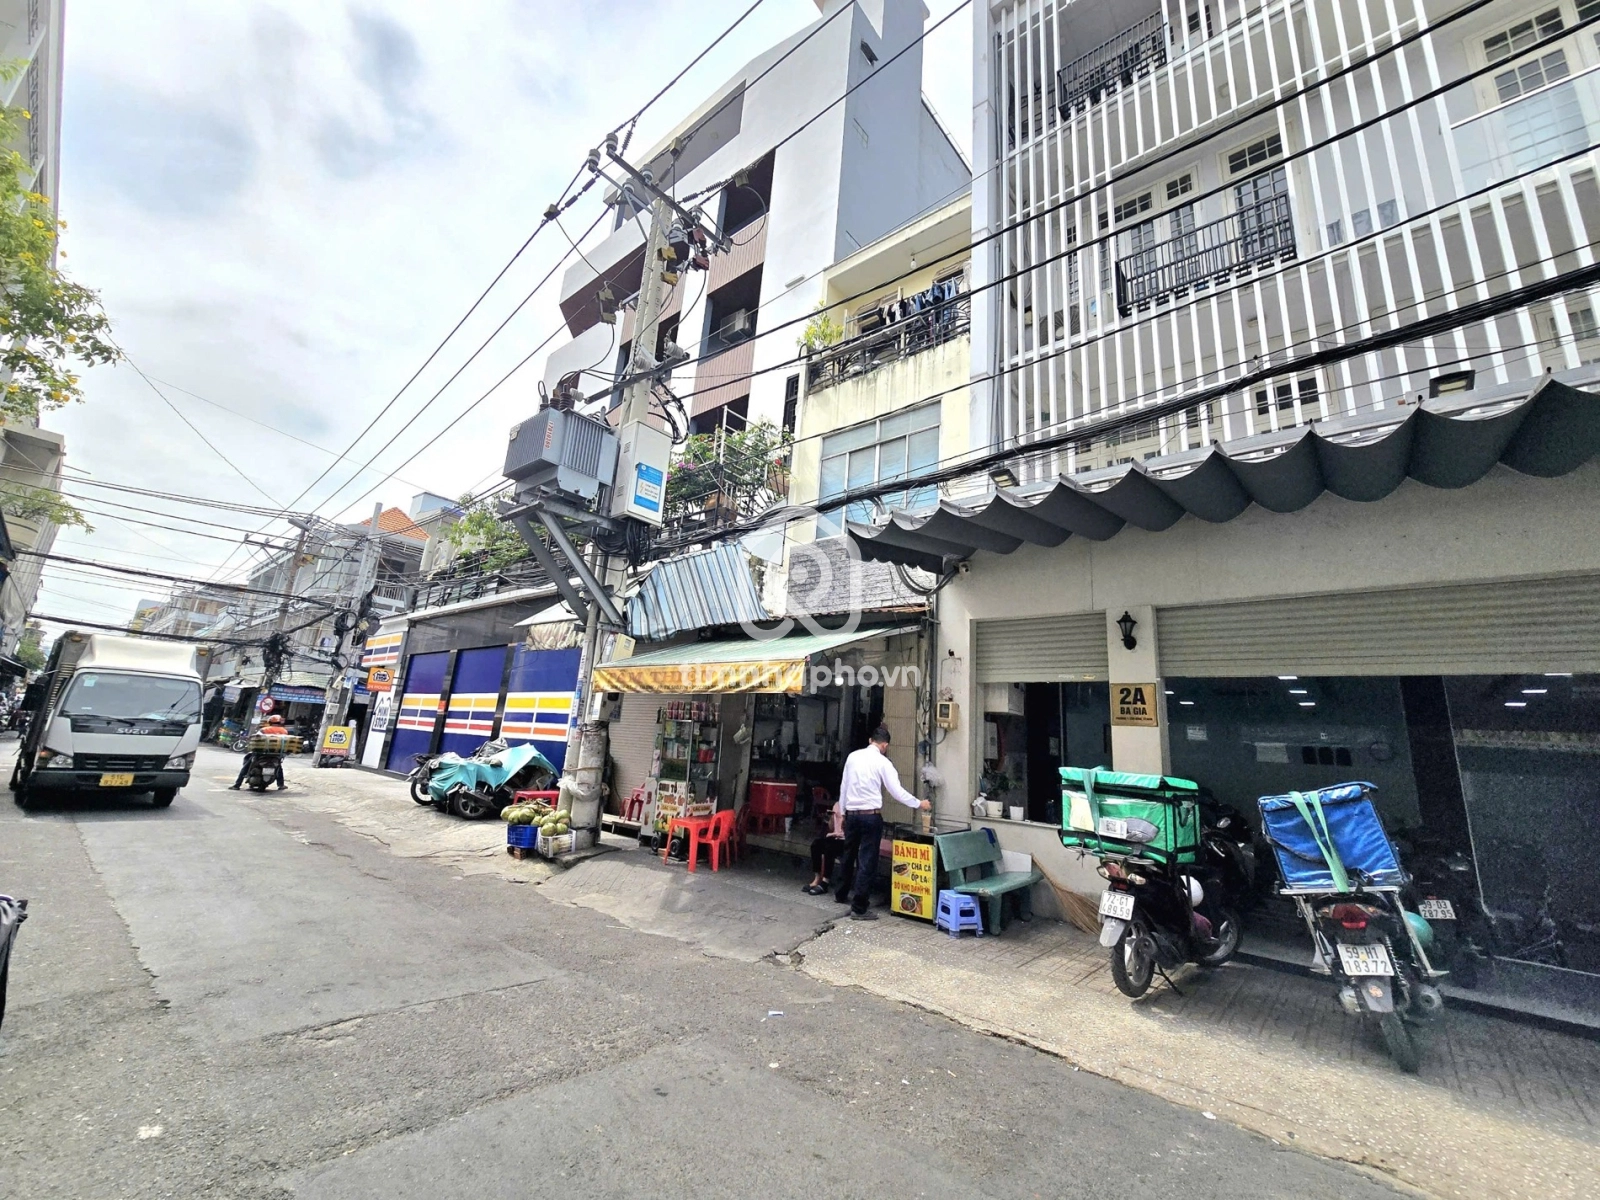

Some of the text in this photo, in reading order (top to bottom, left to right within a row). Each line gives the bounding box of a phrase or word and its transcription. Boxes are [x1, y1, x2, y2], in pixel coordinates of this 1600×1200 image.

[1119, 687, 1147, 705] 2A
[1120, 706, 1147, 716] BA GIA
[895, 843, 930, 861] BÁNH MÌ
[1106, 893, 1129, 907] 72-G1
[1345, 960, 1390, 973] 183.72
